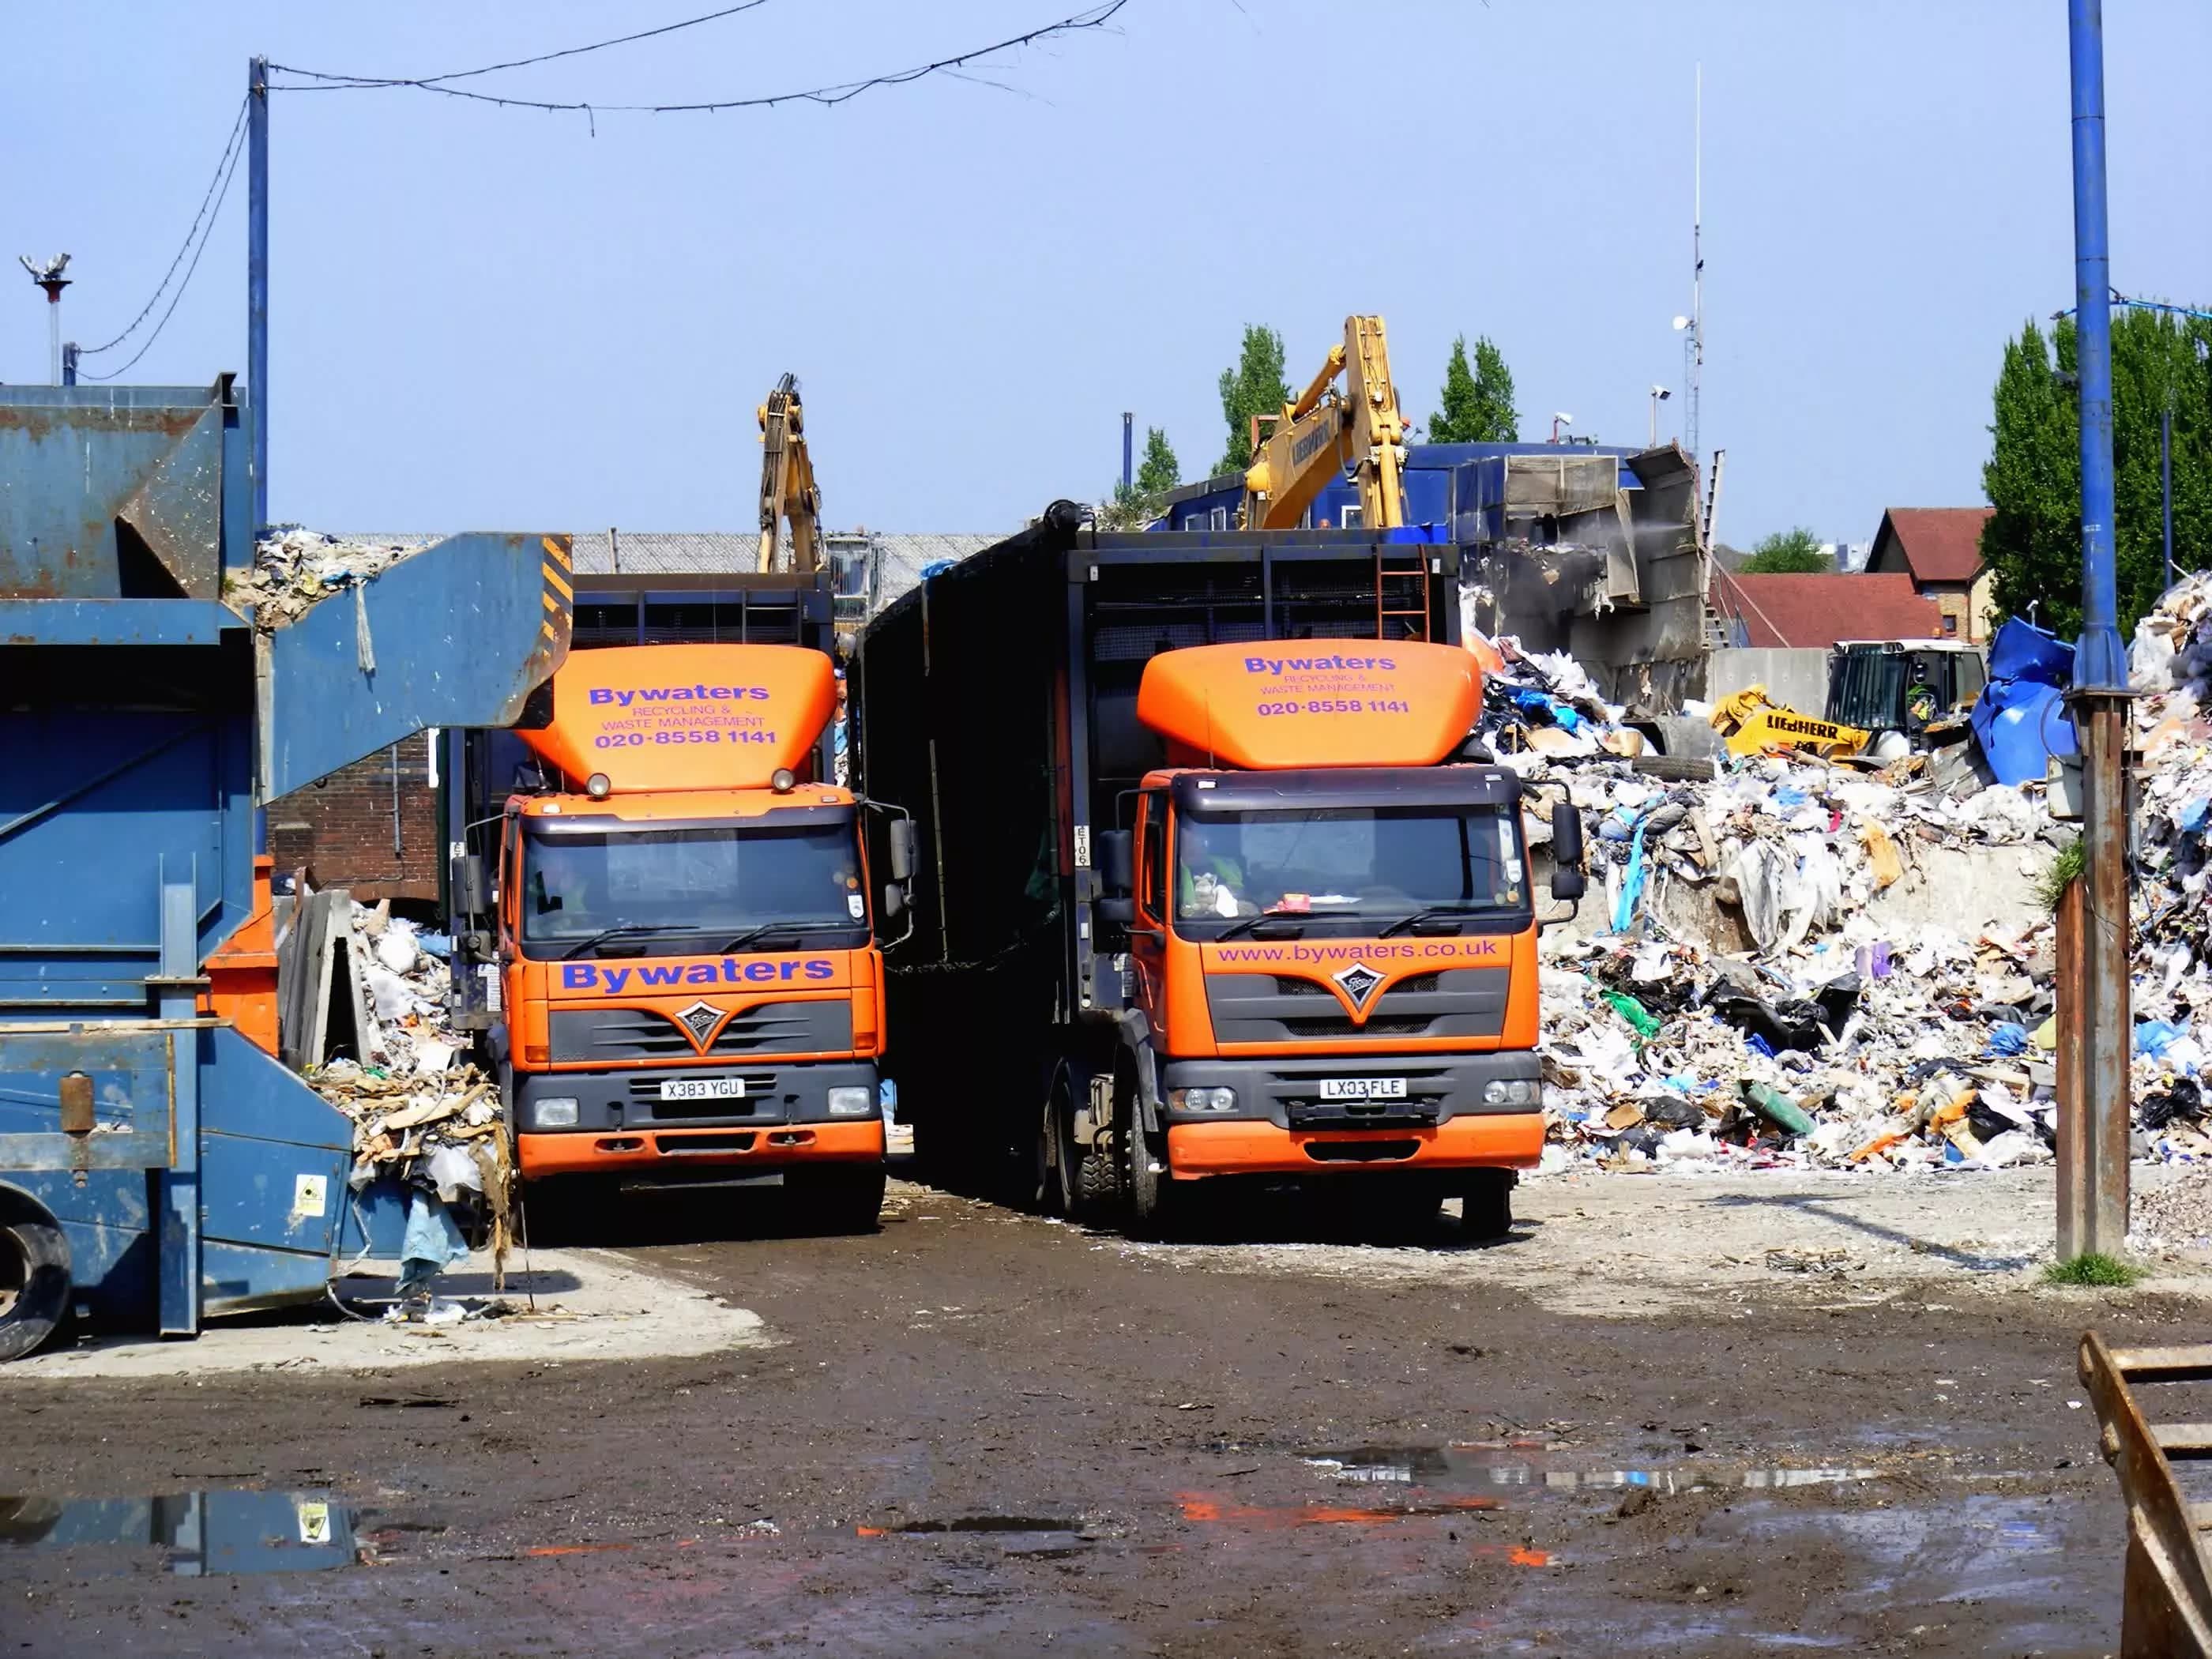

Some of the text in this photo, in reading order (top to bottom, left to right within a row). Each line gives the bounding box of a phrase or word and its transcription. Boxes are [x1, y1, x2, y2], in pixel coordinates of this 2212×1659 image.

[1244, 655, 1396, 675] Bywaters
[1284, 674, 1352, 683] RECYCLING
[589, 684, 769, 707] Bywaters
[1260, 683, 1395, 694] WASTE MANAGEMENT
[633, 705, 715, 716] RECYCLING
[1367, 701, 1409, 713] 1141
[601, 717, 766, 731] WASTE MANAGEMENT
[1766, 714, 1838, 739] LIEBHERR
[728, 732, 776, 743] 1141
[1219, 940, 1497, 964] www.bywaters.co.uk
[562, 958, 833, 994] Bywaters
[668, 1082, 738, 1097] X383 YGU
[1327, 1081, 1400, 1095] LX03 FLE
